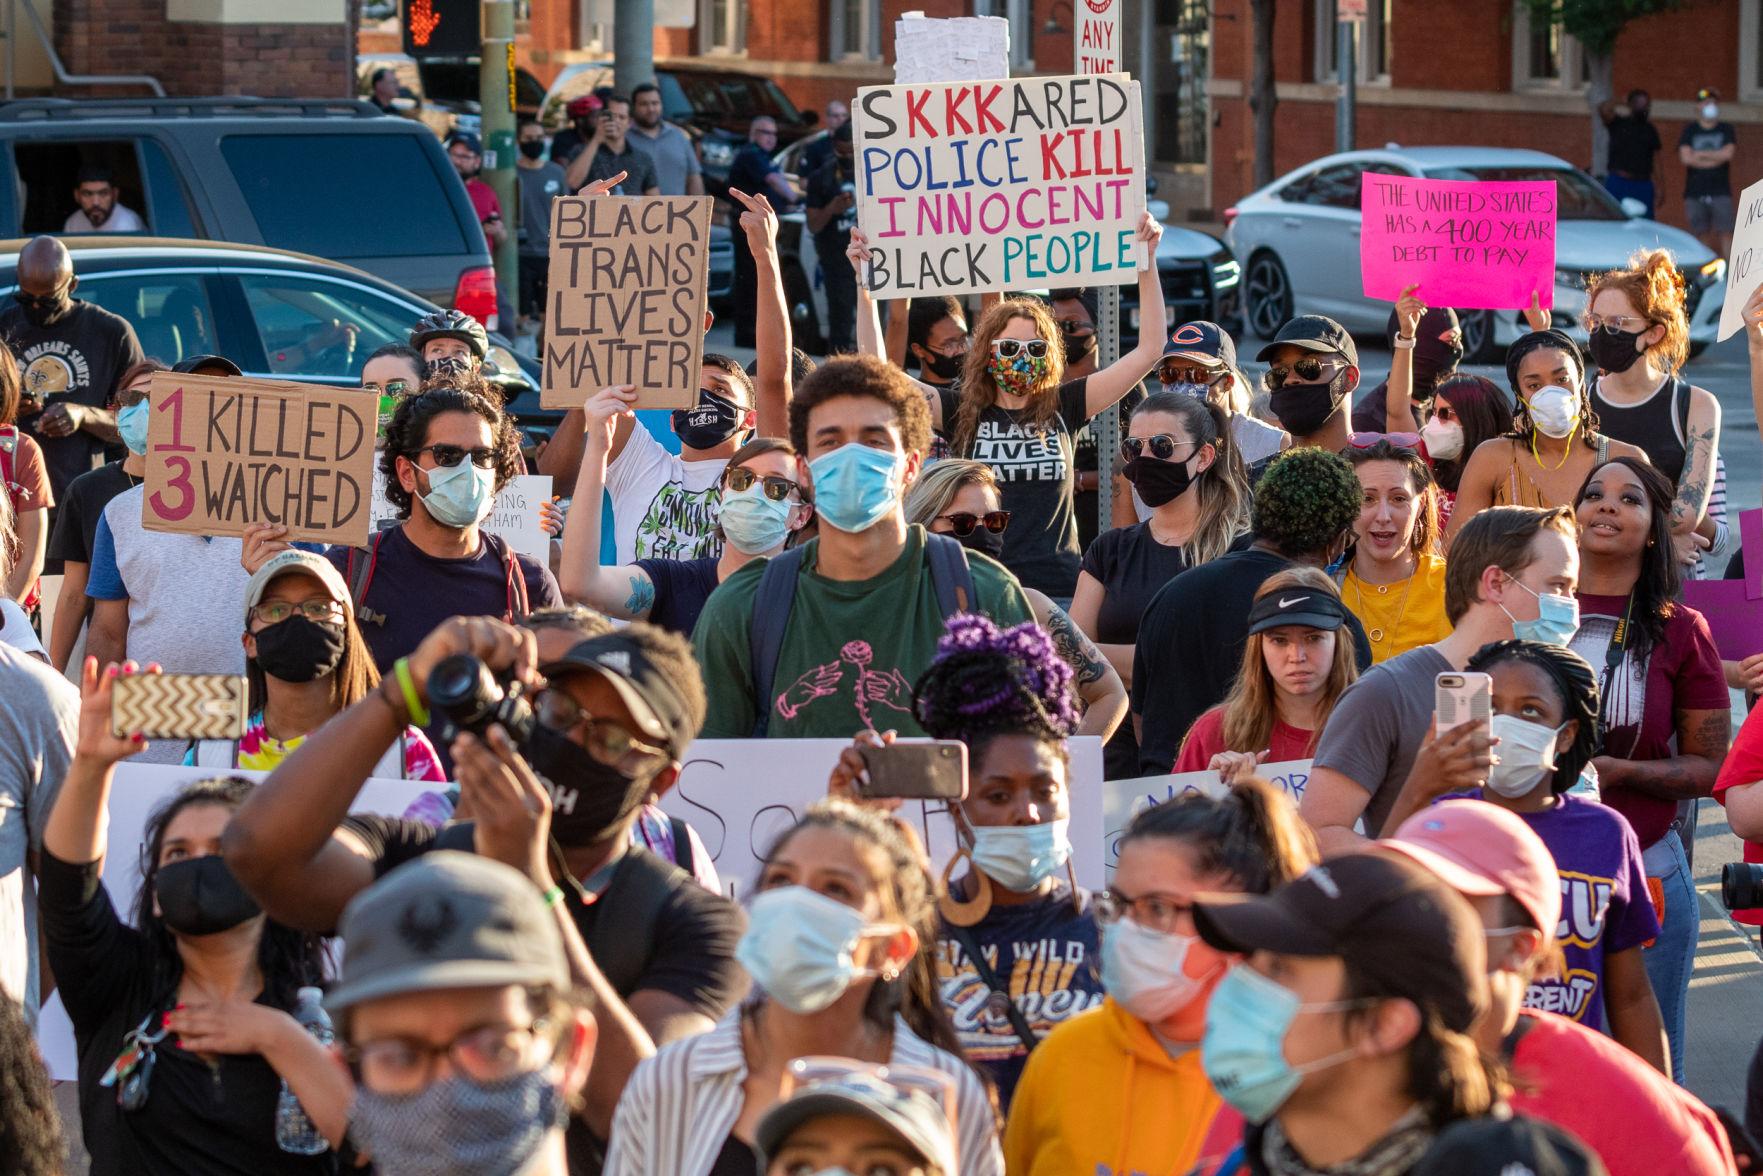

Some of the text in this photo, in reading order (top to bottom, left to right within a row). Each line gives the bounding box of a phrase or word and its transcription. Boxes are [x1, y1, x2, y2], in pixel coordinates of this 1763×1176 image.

[1082, 18, 1114, 51] ANY
[1081, 56, 1114, 75] TIME
[863, 129, 1133, 196] POLICE KILL
[878, 179, 1130, 238] INNOCENT
[1373, 183, 1553, 213] THE UNITED STATES
[556, 200, 699, 241] BLACK
[1385, 214, 1553, 245] HAS A 400 YEAR
[559, 242, 695, 290] TRANS
[868, 230, 1137, 291] BLACK PEOPLE
[1393, 245, 1529, 267] DEBT TO PAY
[1732, 247, 1753, 289] NO
[555, 287, 694, 338] LIVES
[24, 340, 90, 388] ORLEANS SAINTS
[546, 339, 691, 390] MATTER
[154, 387, 364, 462] 1 KILLED
[973, 439, 1060, 460] LIVES
[990, 461, 1067, 482] ATTER
[149, 455, 361, 530] 3 WATCHED
[1613, 617, 1626, 643] Nikon
[1012, 937, 1085, 965] WILD
